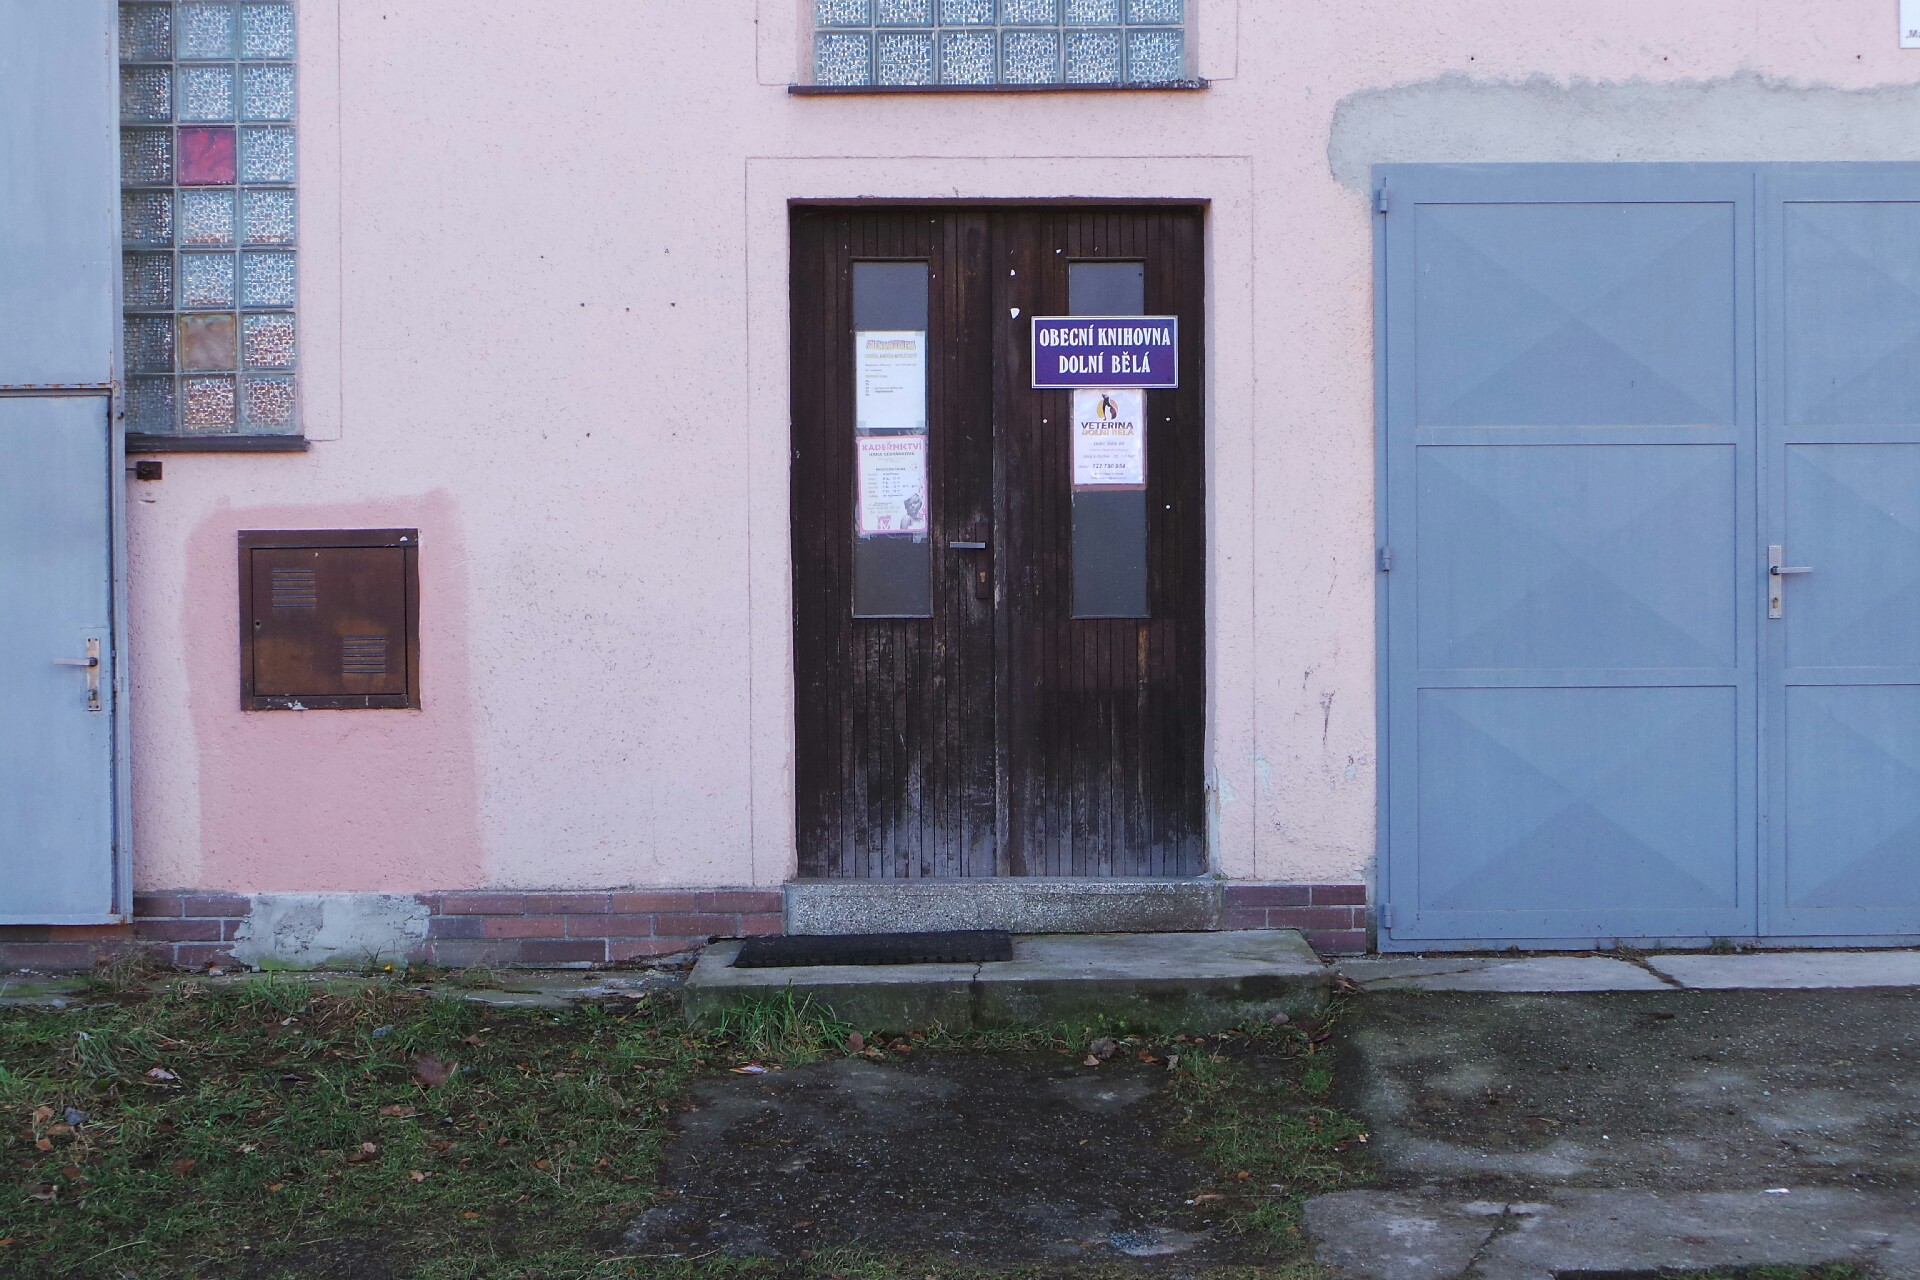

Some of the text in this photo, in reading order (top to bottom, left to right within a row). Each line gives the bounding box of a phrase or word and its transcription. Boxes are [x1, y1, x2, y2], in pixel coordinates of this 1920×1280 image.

[1039, 324, 1171, 347] OBECNÍ KNIHOVNA
[1059, 351, 1151, 374] DOLNÍ BĚLÁ
[862, 440, 922, 451] KADEŘNICTVÍ
